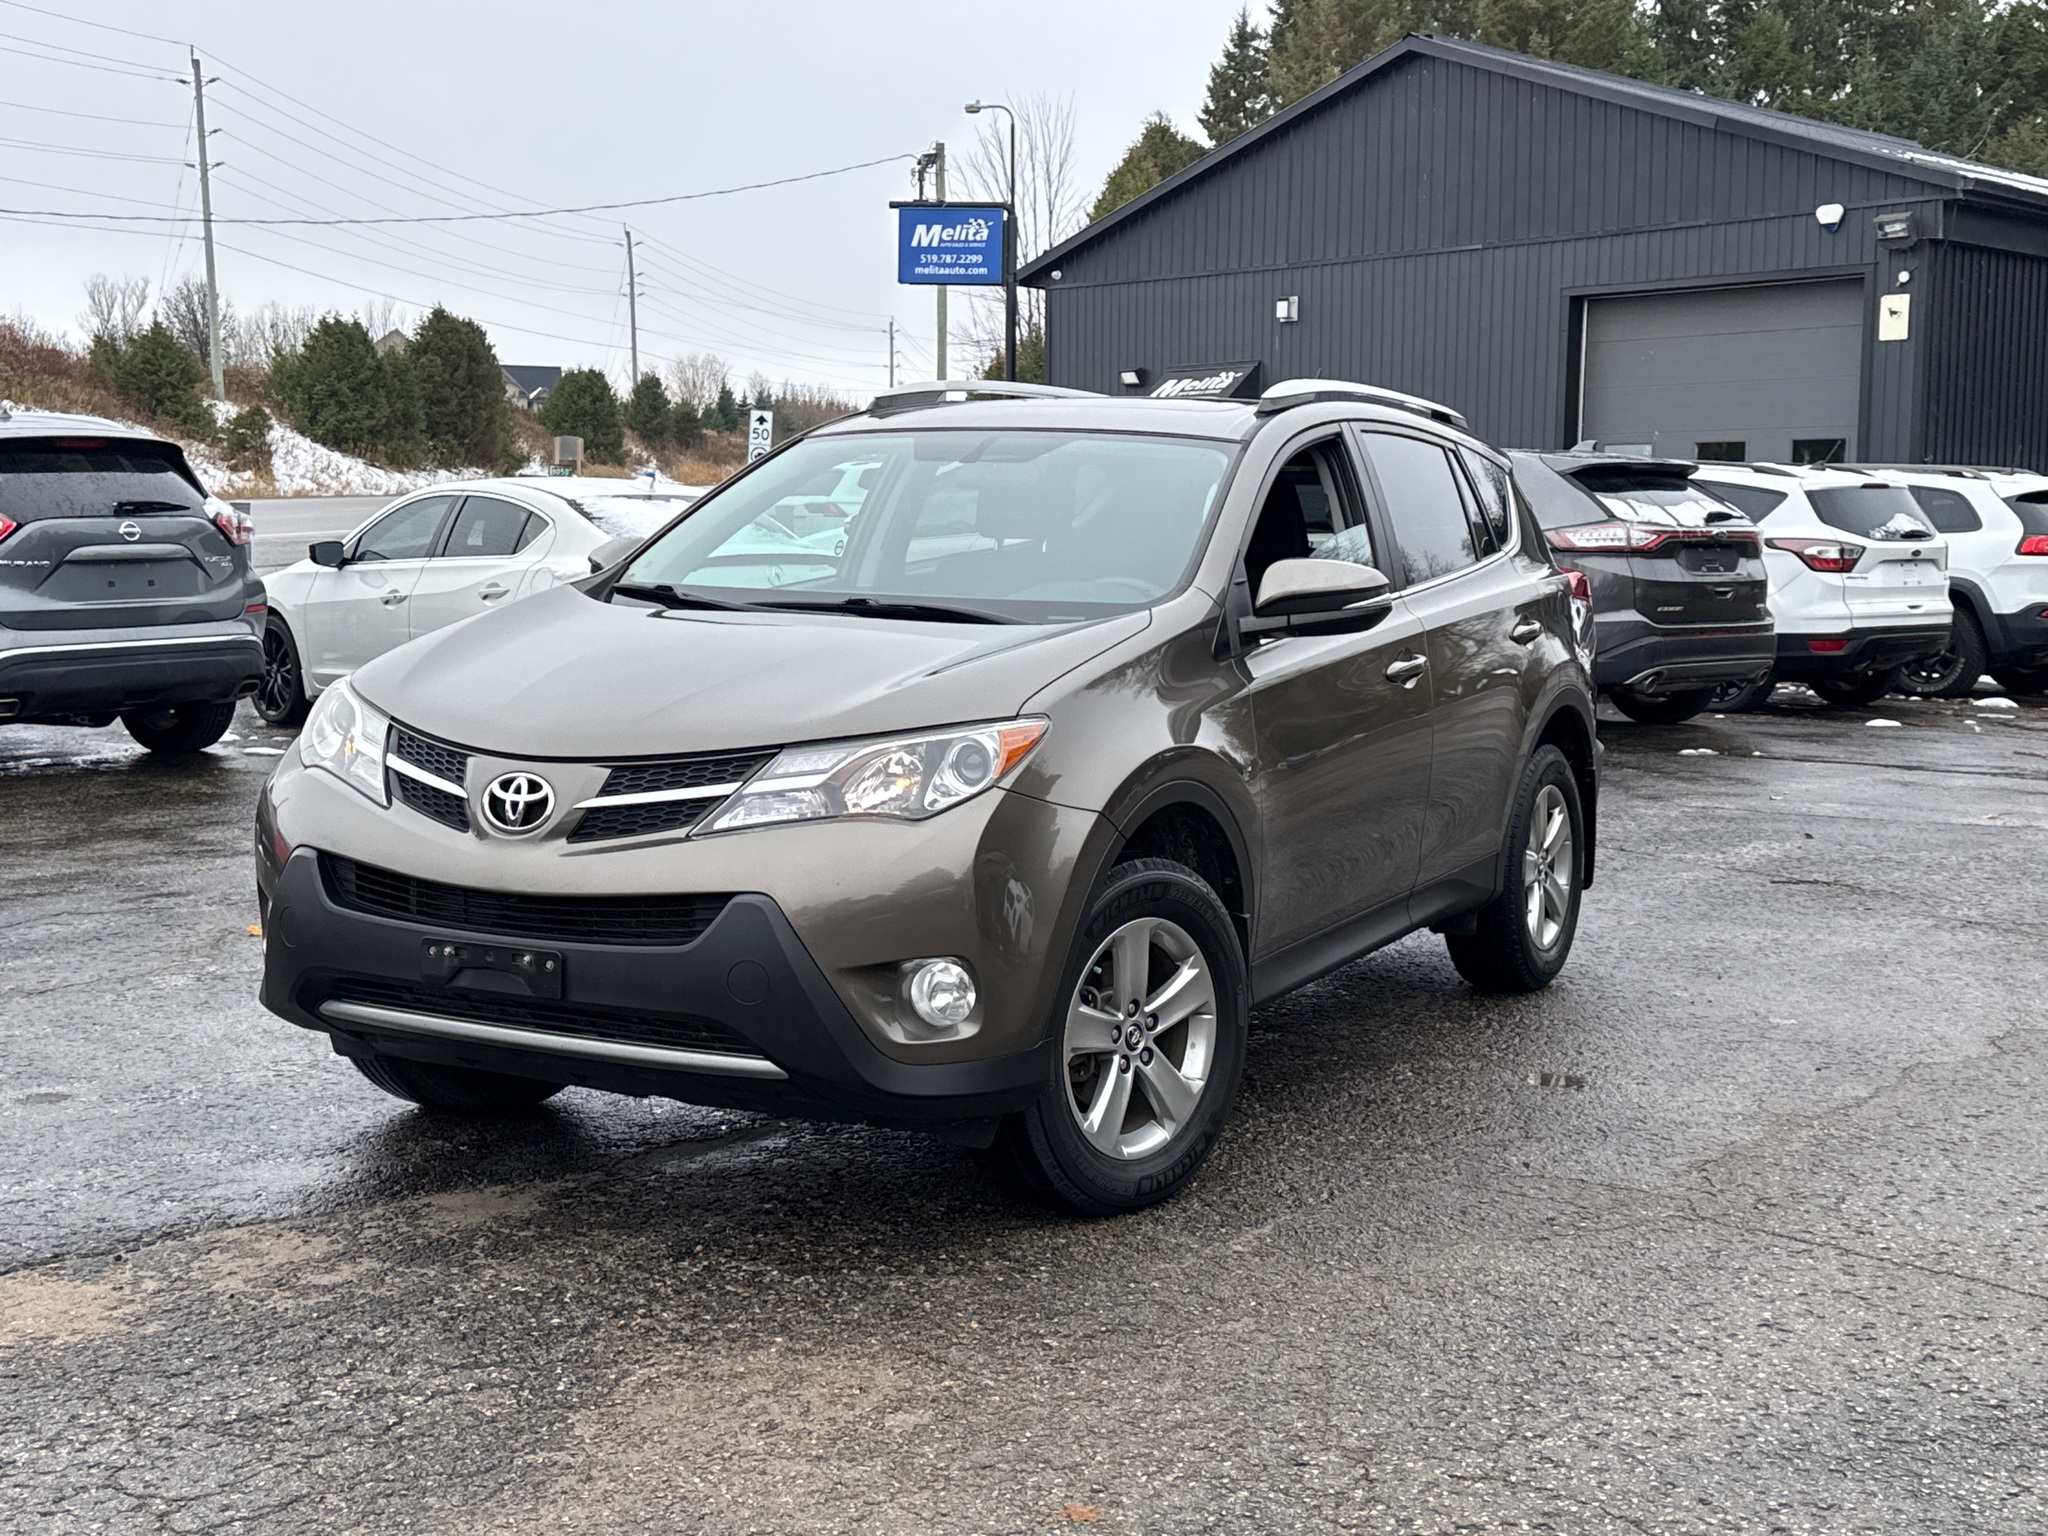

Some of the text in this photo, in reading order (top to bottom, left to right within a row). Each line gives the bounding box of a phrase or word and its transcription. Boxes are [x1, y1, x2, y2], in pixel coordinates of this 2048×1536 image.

[910, 222, 990, 248] Melita
[920, 254, 984, 264] 519.787.2299
[915, 265, 988, 275] melitaauto.com
[752, 427, 770, 441] 50
[1092, 882, 1167, 938] MICHELIN
